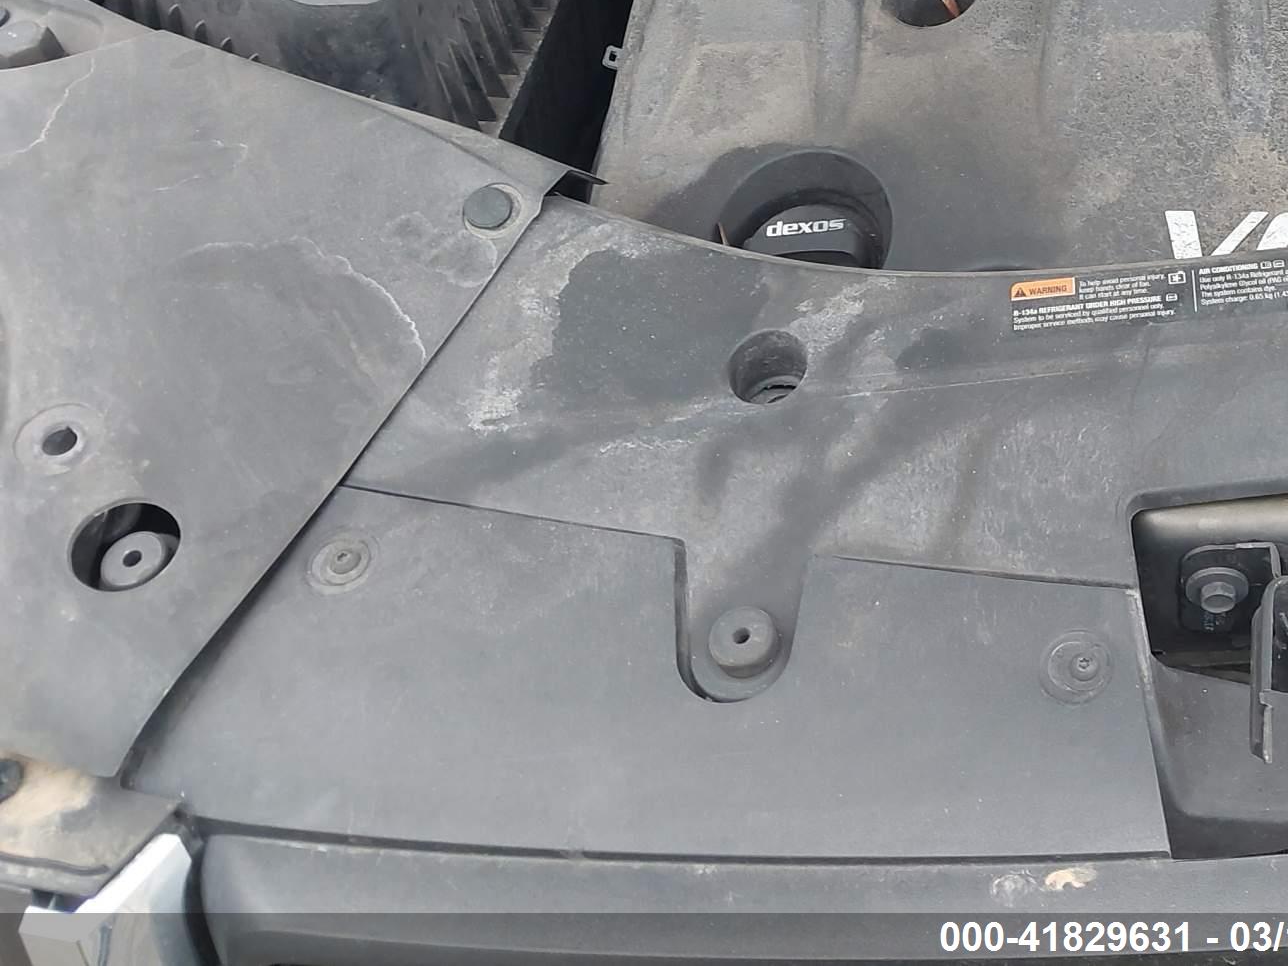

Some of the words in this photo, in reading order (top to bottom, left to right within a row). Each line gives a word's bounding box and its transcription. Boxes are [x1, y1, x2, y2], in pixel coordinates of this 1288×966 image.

[766, 218, 847, 237] dexos
[1211, 262, 1259, 274] CONDITIONING
[1028, 284, 1067, 296] WARNING
[1039, 303, 1084, 314] REFRIGERANT
[1085, 300, 1109, 309] UNDER
[1109, 299, 1126, 307] HIGH
[1127, 295, 1162, 305] PRESSURE
